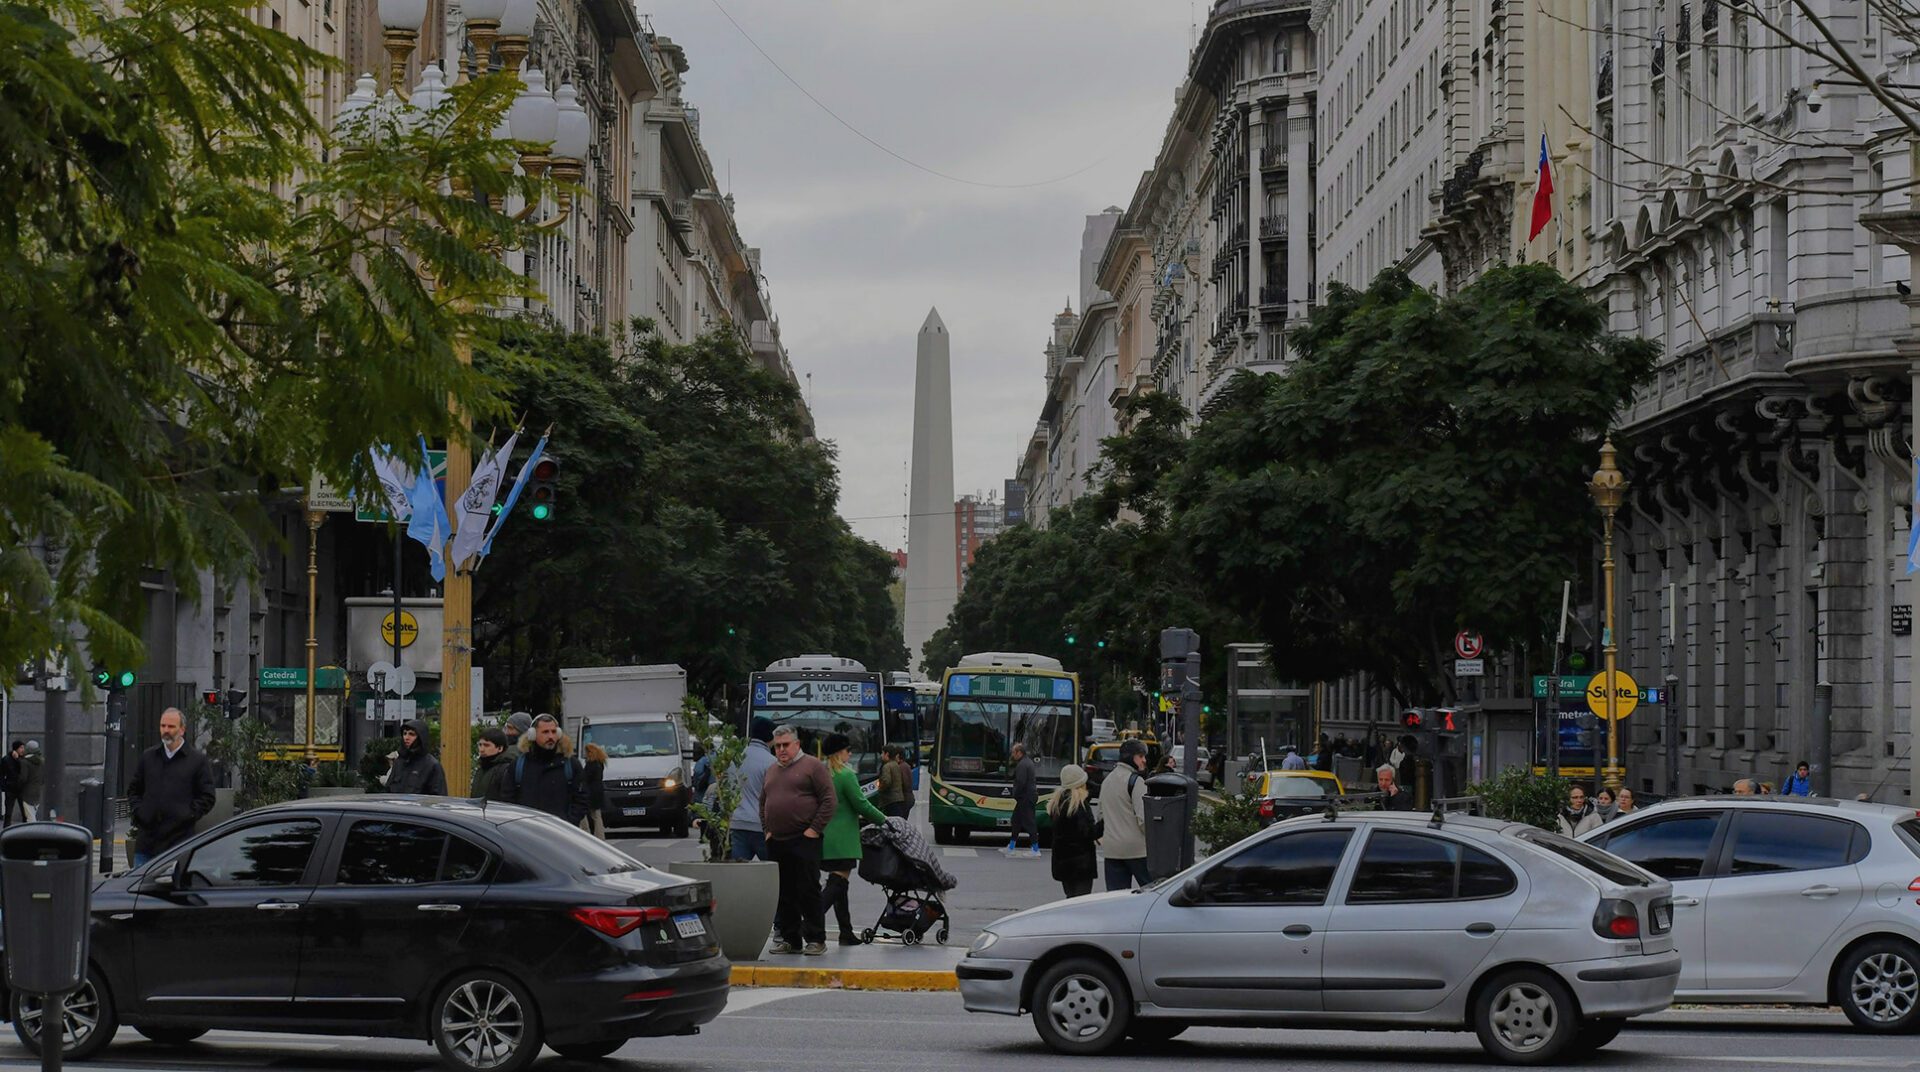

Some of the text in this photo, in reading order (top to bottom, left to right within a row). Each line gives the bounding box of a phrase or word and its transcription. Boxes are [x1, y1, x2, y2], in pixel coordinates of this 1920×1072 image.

[263, 670, 297, 679] Catedral
[972, 676, 1046, 698] 111
[767, 683, 858, 702] 24 WILDE
[1639, 691, 1646, 700] D
[1658, 691, 1664, 700] E
[822, 693, 834, 702] DEL
[836, 693, 861, 703] PARQUE
